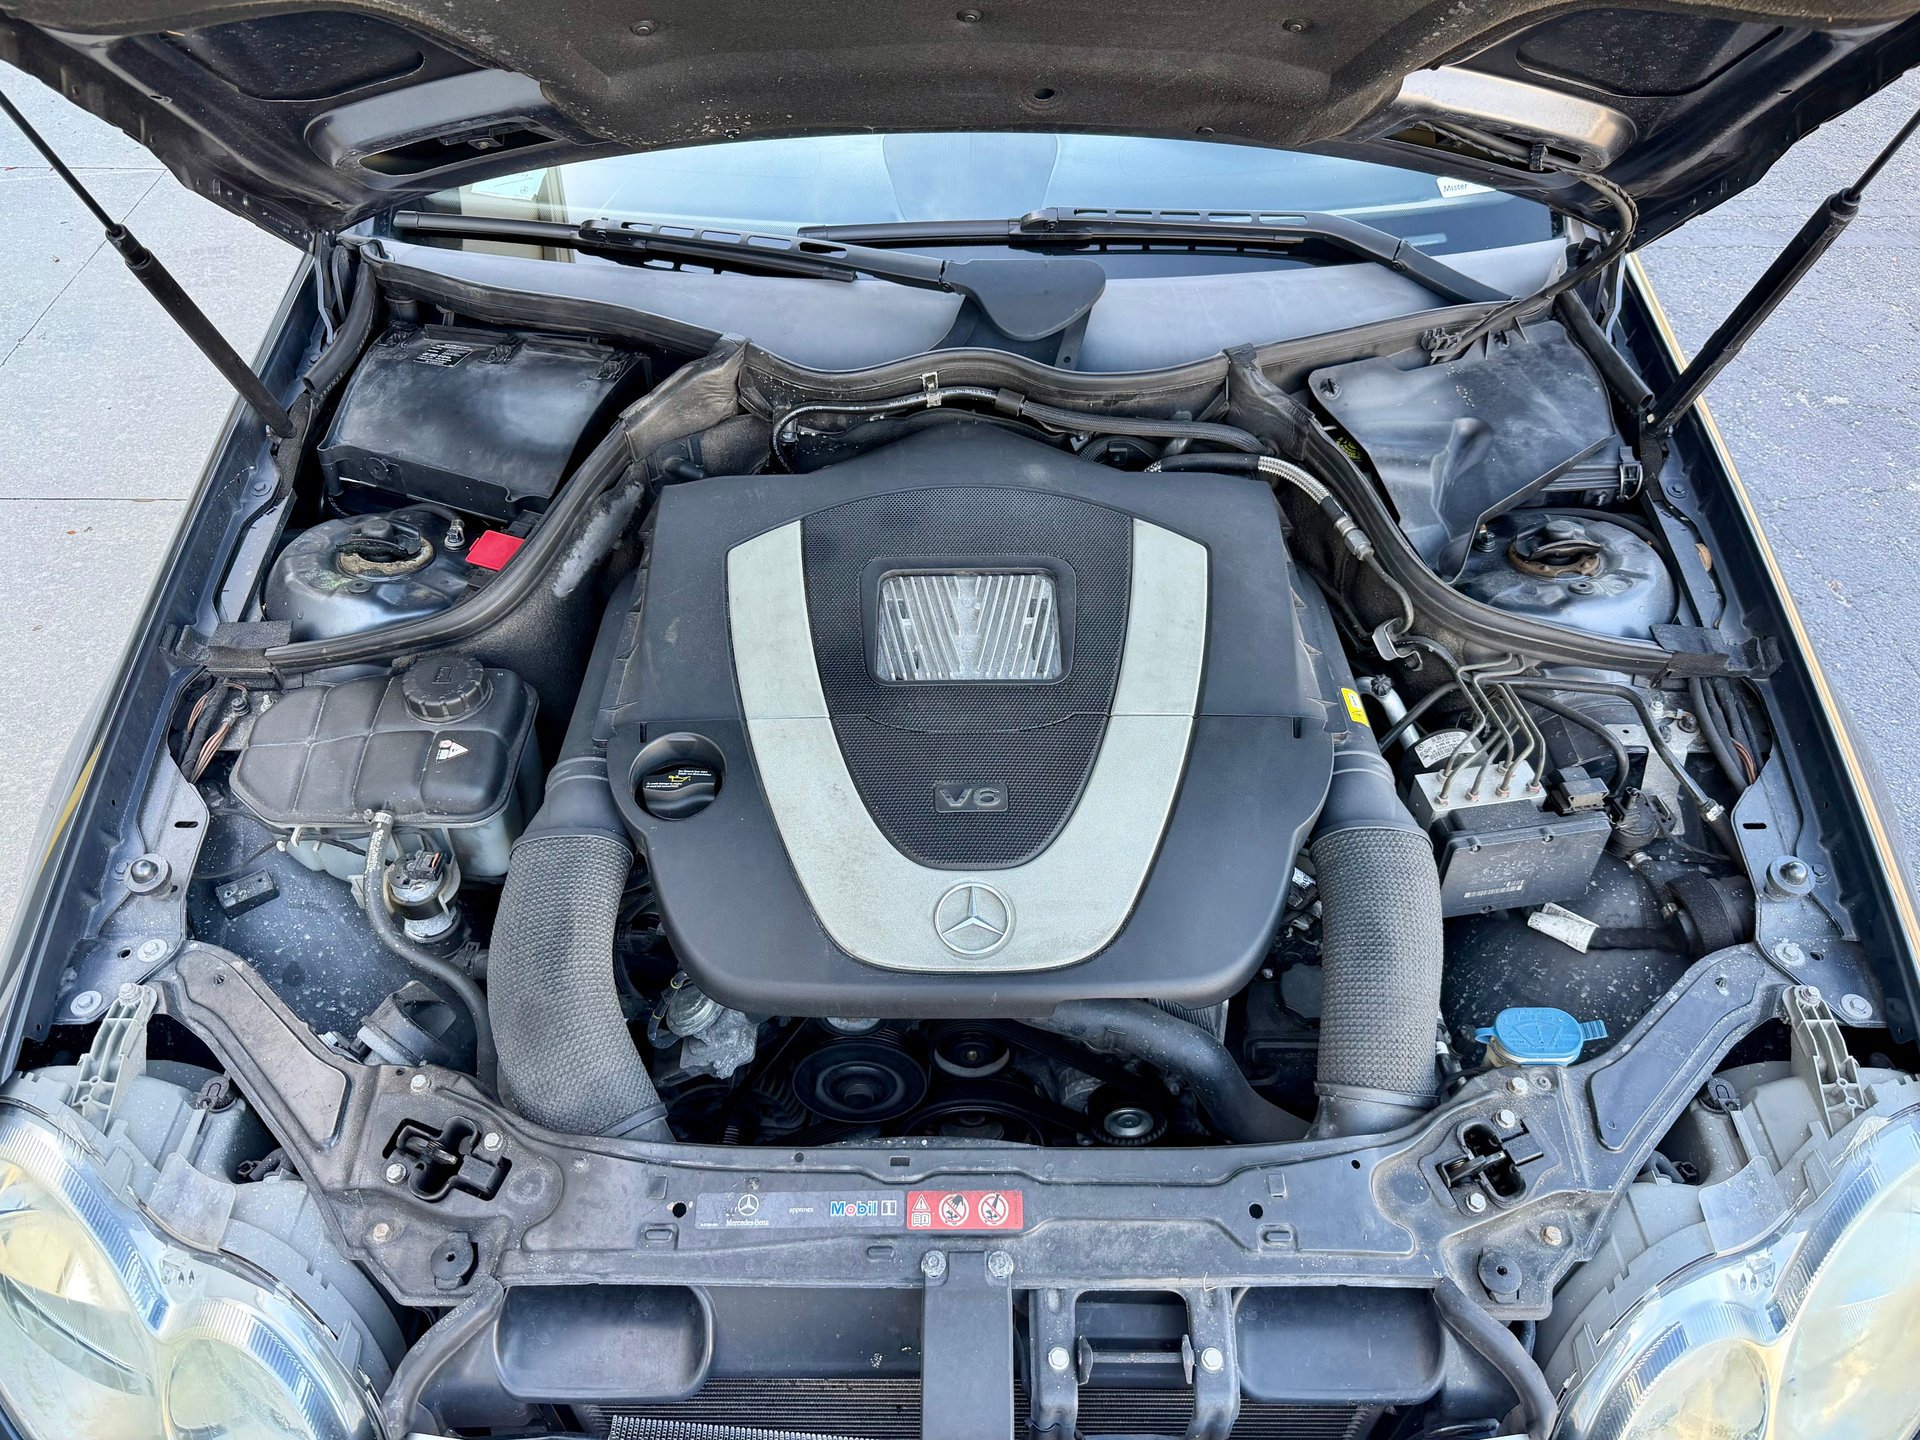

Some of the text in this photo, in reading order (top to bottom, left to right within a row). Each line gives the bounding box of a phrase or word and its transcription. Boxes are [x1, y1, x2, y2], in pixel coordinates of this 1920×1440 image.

[1443, 183, 1468, 192] Mister
[939, 787, 1001, 807] V6
[830, 1200, 878, 1216] Mobil
[726, 1218, 770, 1226] Mercedes-Benz
